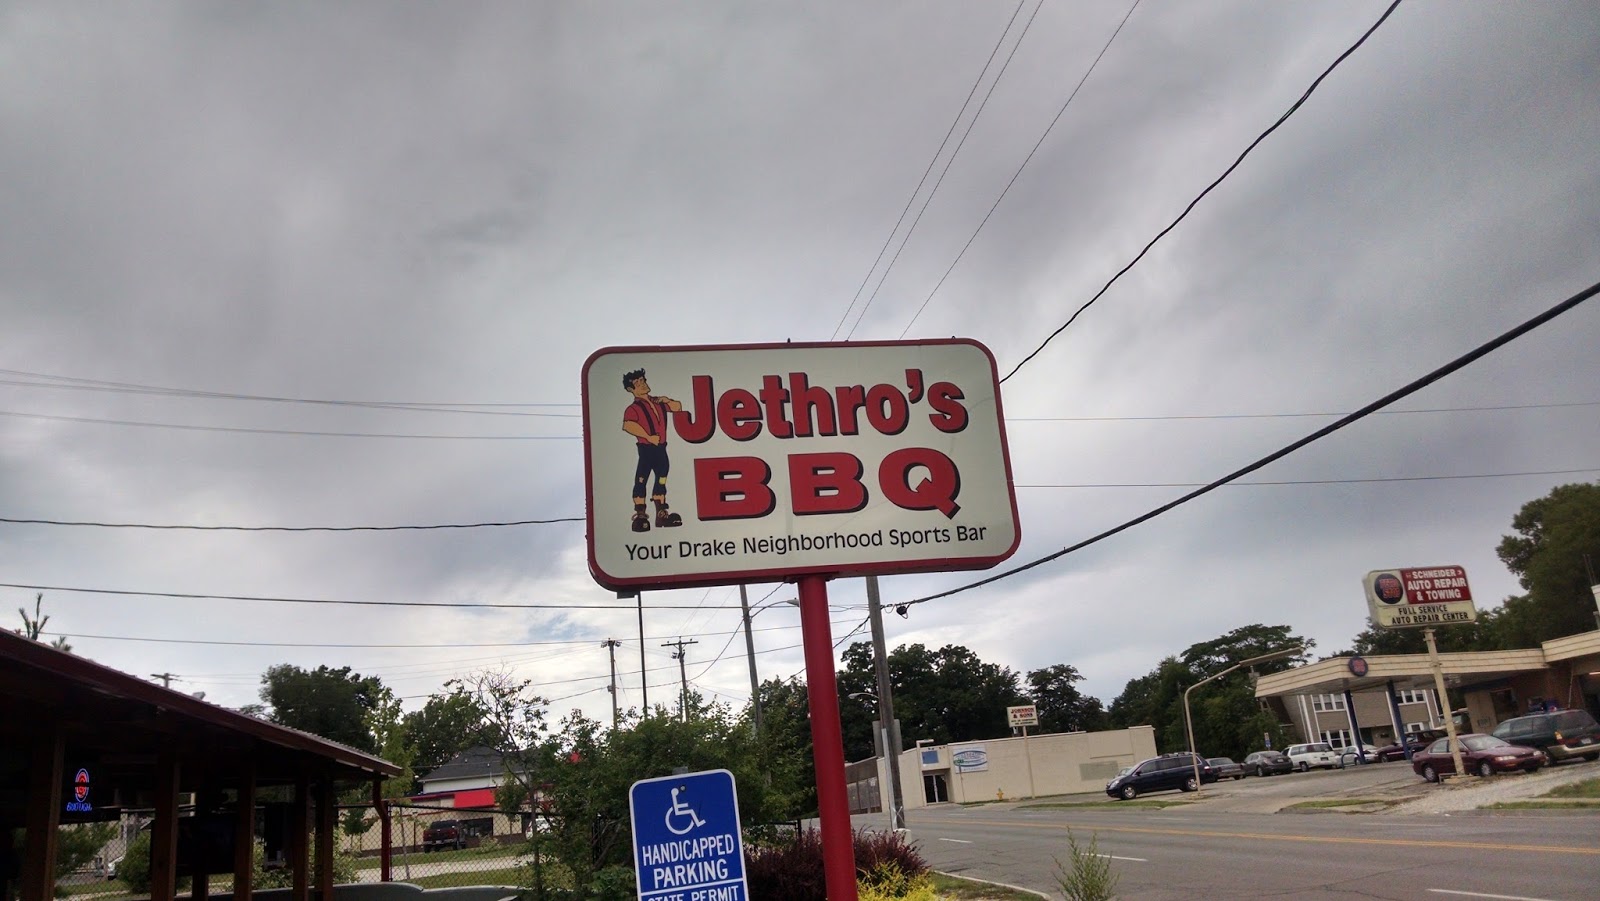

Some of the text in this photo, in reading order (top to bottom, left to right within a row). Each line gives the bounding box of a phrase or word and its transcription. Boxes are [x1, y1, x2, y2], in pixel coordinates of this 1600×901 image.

[673, 368, 970, 444] Jethro's
[693, 447, 962, 522] BBQ
[625, 525, 987, 561] Your Drake Neighborhood Sports Bar
[1412, 569, 1456, 579] SCHNEIDER
[1407, 580, 1432, 591] AUTO
[1434, 577, 1467, 589] REPAIR
[1416, 589, 1461, 601] & TOWING
[1391, 611, 1469, 625] AUTO REPAIR CENTER
[1398, 604, 1448, 616] FULL SERVICE
[642, 834, 735, 866] HANDICAPPED
[653, 858, 728, 889] PARKING
[691, 885, 739, 901] PERMIT
